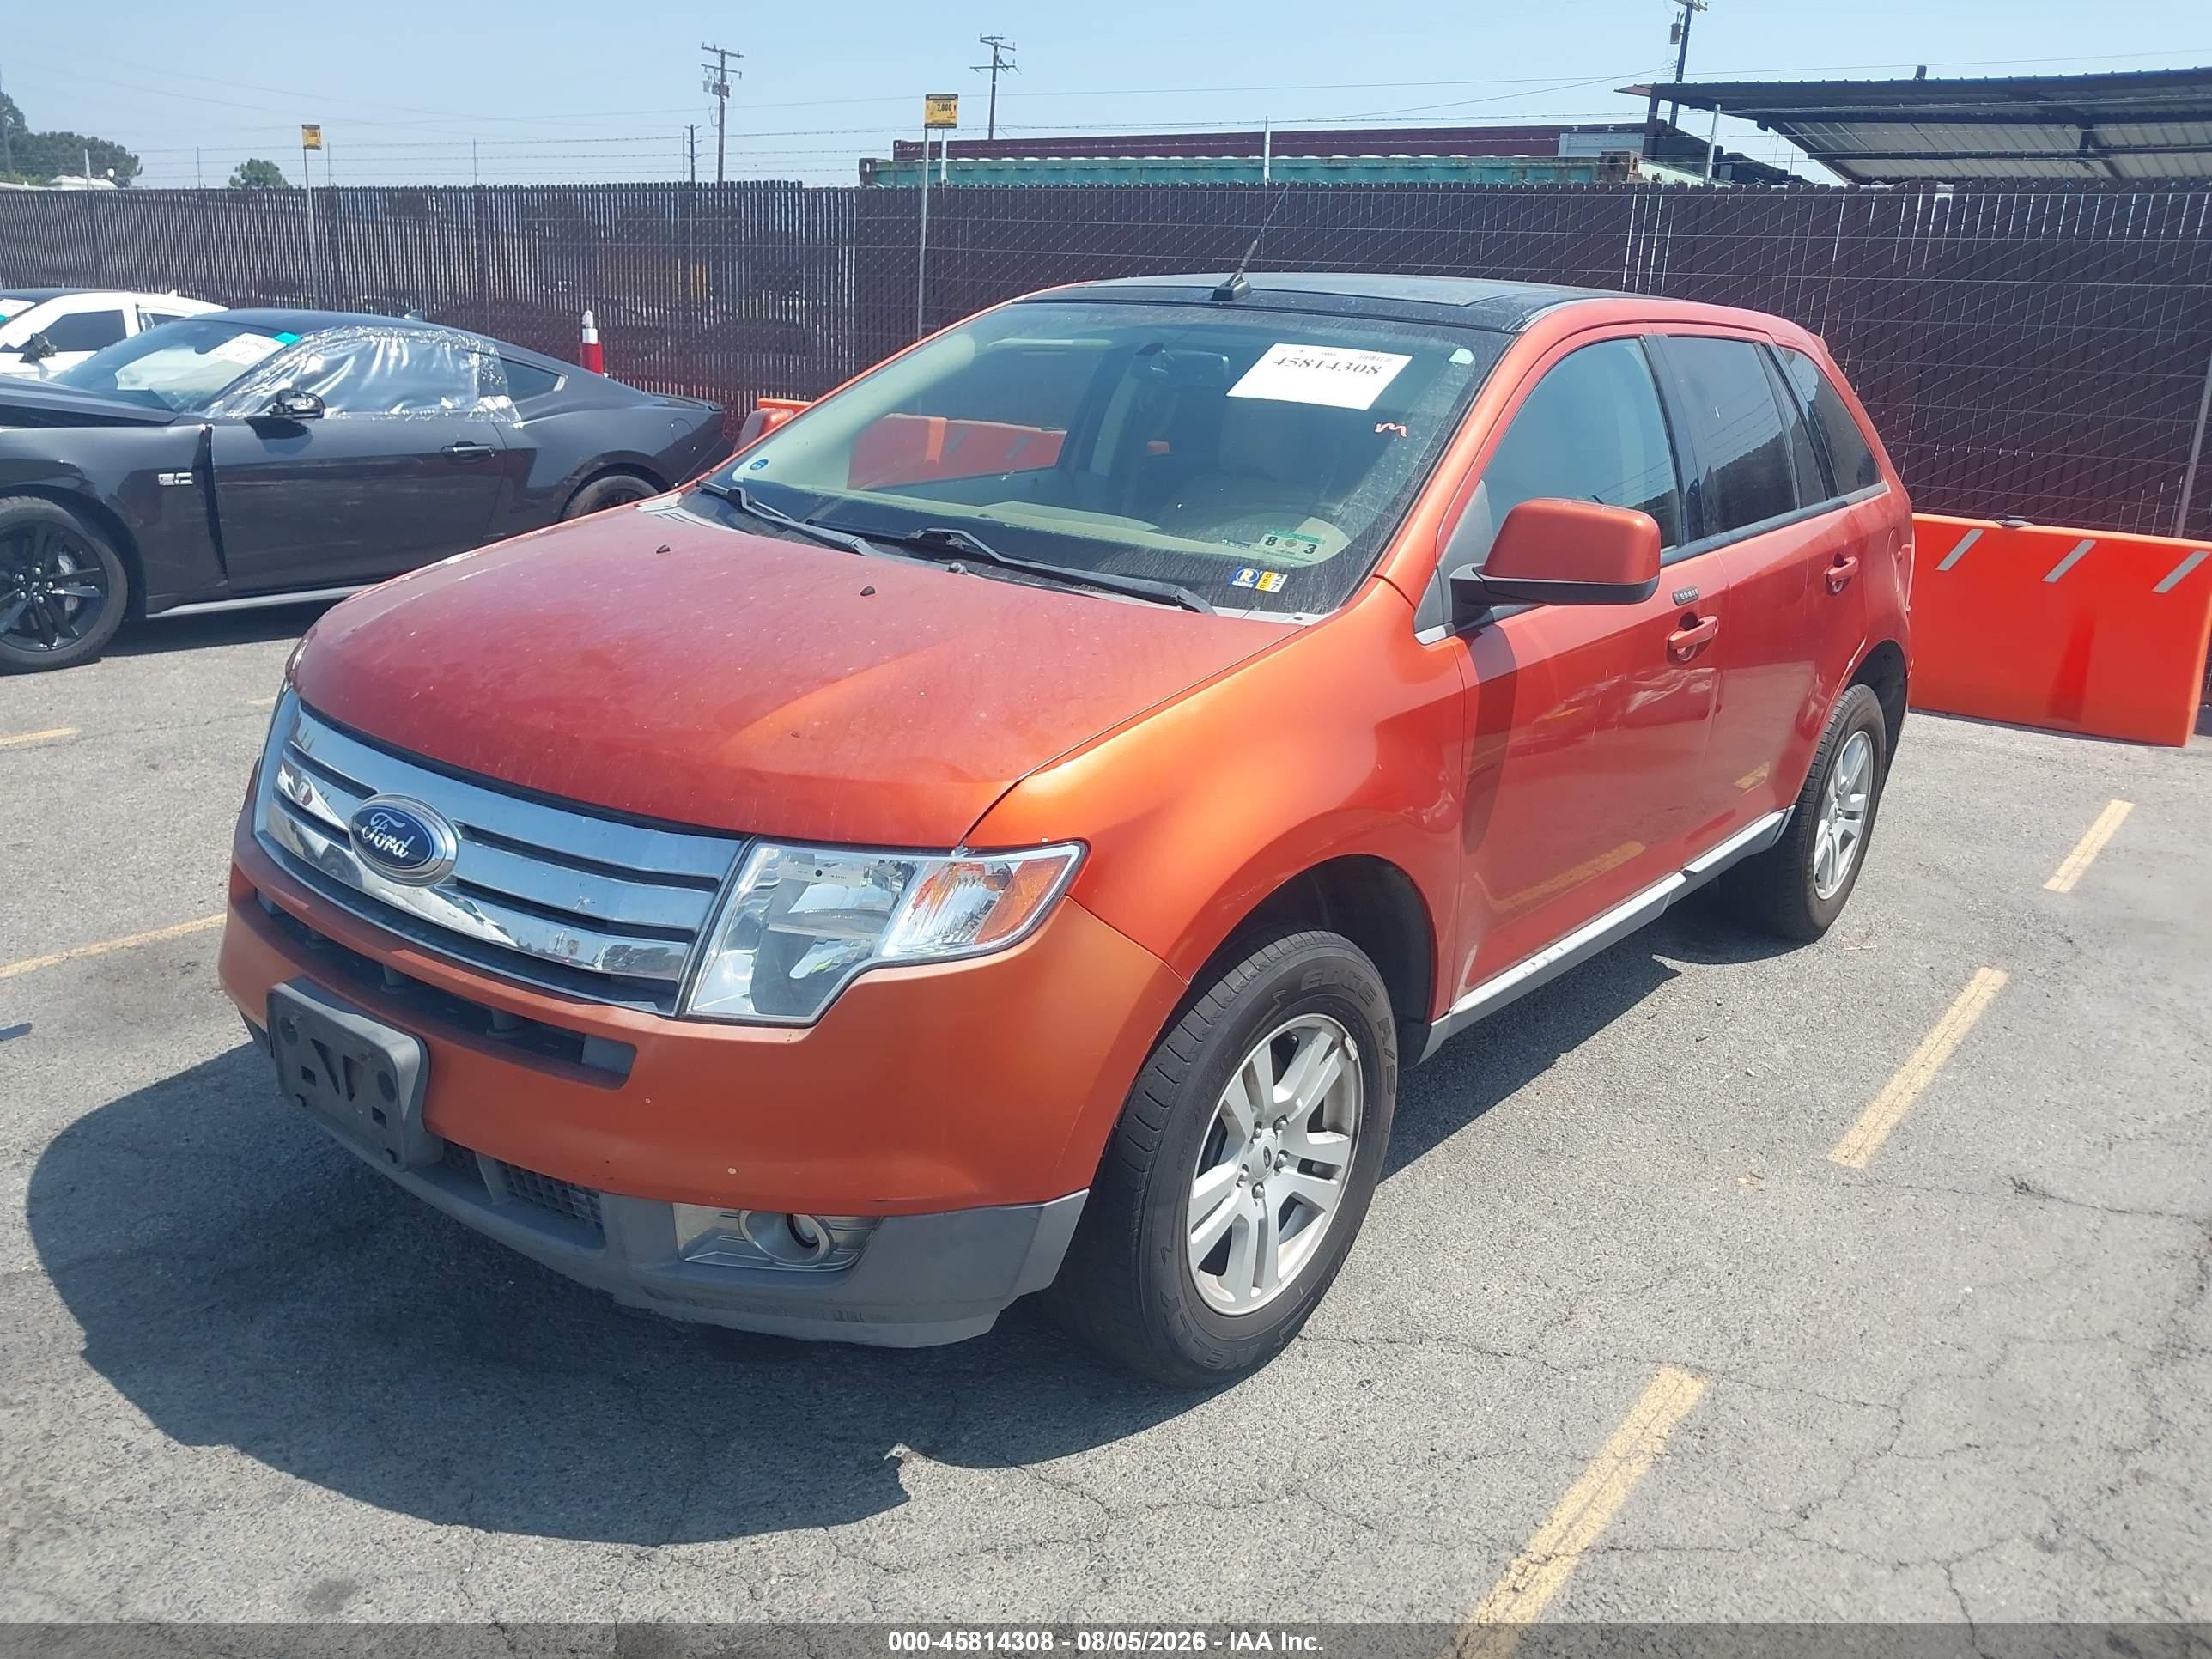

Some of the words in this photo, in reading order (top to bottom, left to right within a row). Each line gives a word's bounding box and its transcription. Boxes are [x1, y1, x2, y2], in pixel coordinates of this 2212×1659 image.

[1273, 357, 1382, 375] 45814308
[1264, 536, 1279, 547] 8
[1304, 544, 1317, 555] 3
[361, 811, 416, 858] Ford
[1300, 968, 1377, 1007] EDGE
